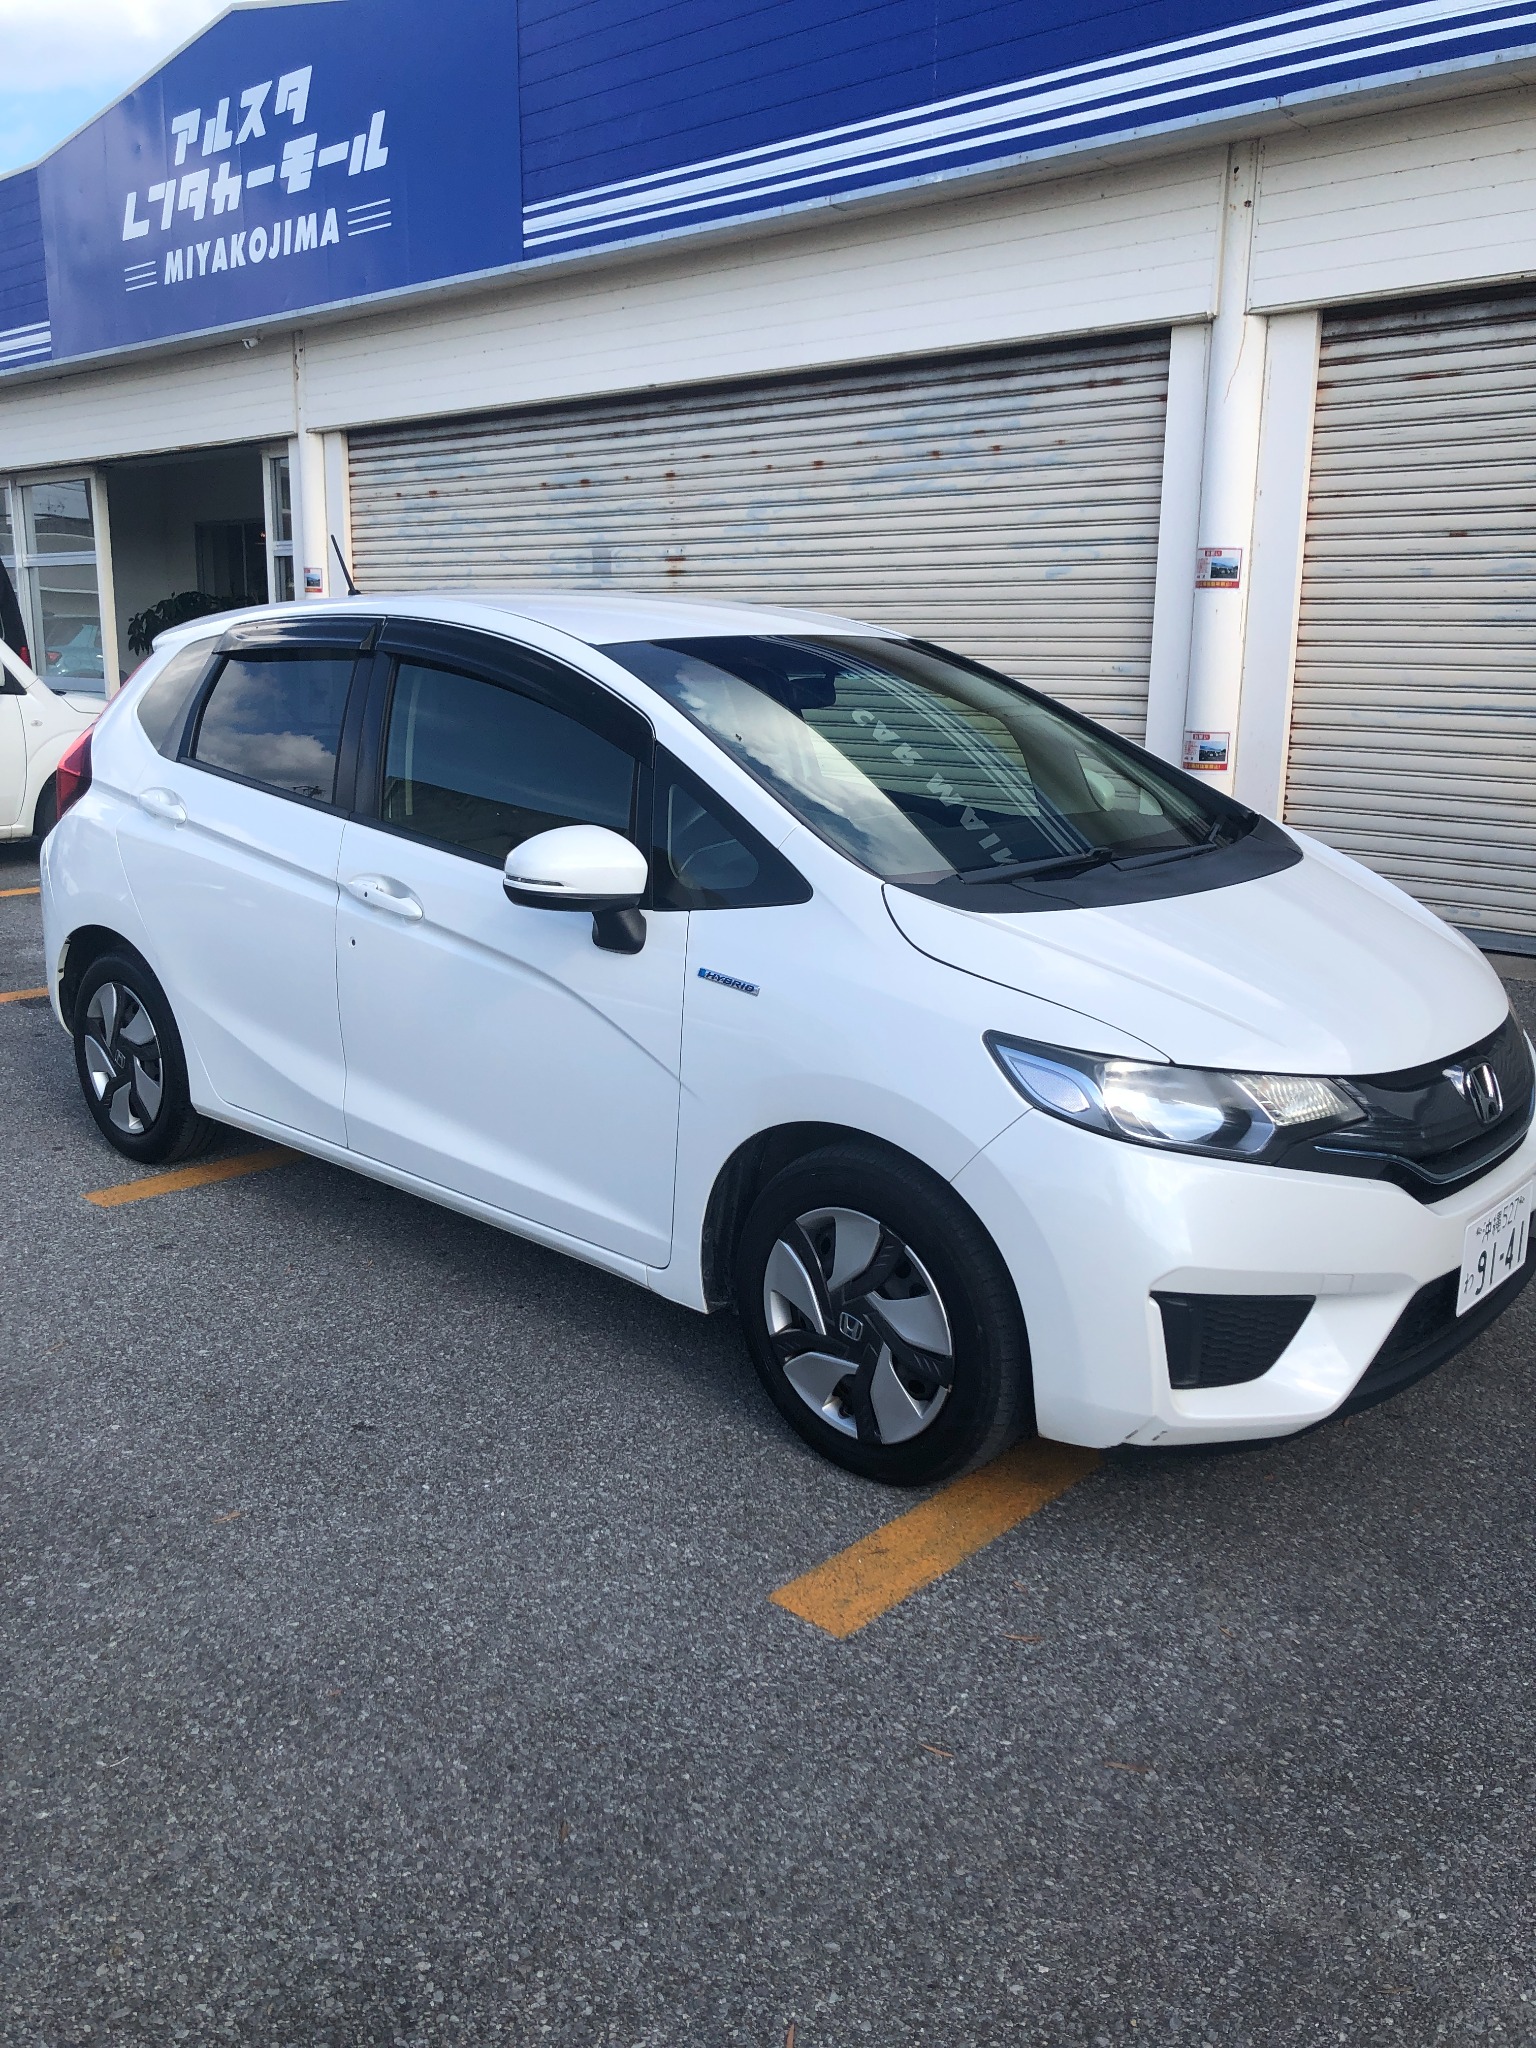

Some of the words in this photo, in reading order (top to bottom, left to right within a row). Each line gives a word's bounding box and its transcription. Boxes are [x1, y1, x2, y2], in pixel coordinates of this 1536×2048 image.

[171, 65, 312, 166] アルスタ
[122, 110, 389, 241] レンタカーモール
[164, 207, 340, 285] MIYAKOJIMA
[706, 971, 755, 993] HYBRID
[1464, 1272, 1475, 1295] わ
[1475, 1220, 1525, 1296] 91-41
[1481, 1210, 1502, 1243] 沖縄
[1502, 1197, 1520, 1229] 527
